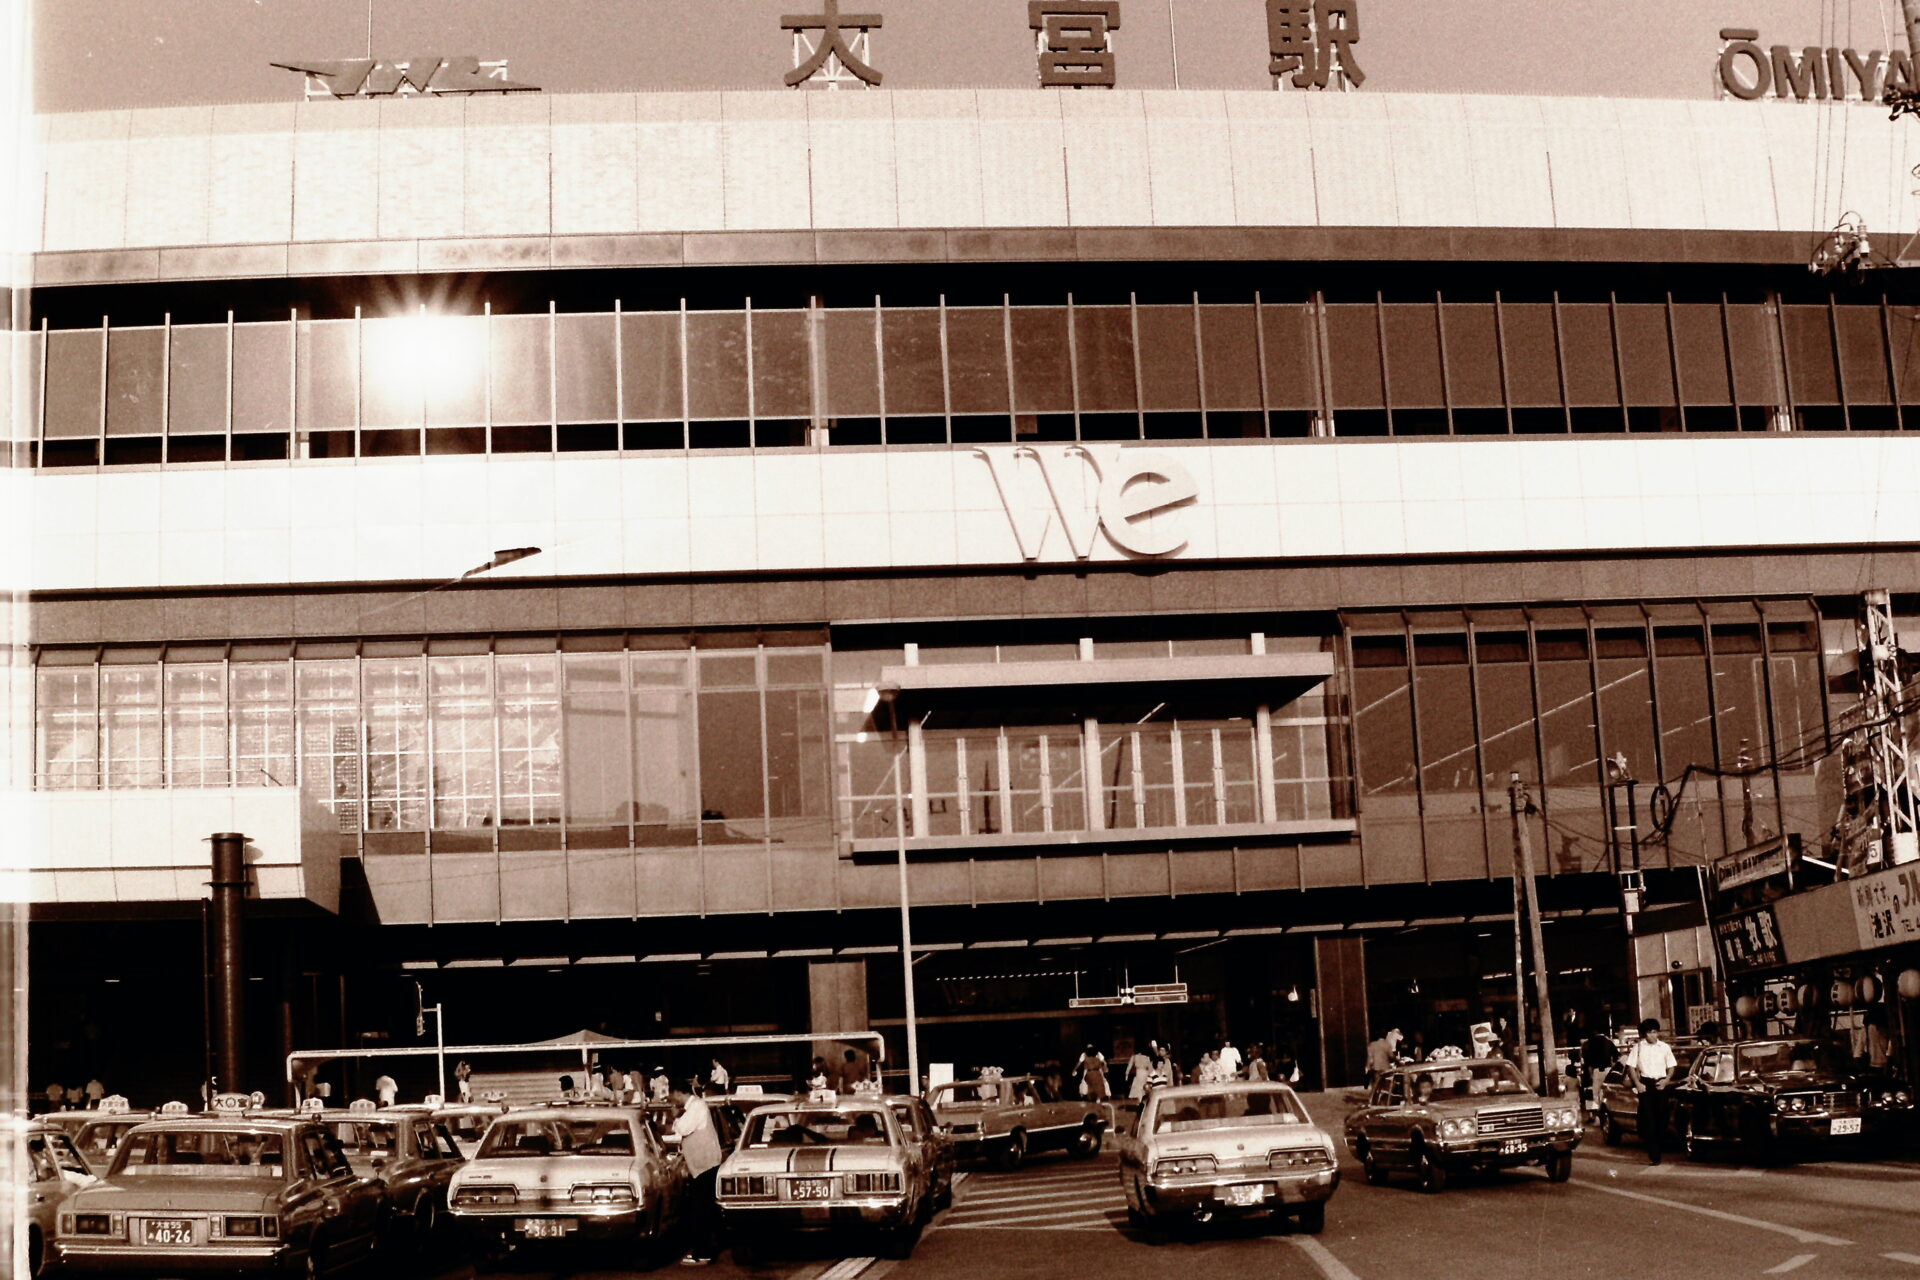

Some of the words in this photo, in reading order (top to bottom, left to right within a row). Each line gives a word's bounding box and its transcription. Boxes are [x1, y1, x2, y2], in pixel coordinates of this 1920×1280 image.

[780, 0, 1367, 89] 大宮駅
[972, 444, 1200, 563] We
[799, 1186, 829, 1198] 57-50
[155, 1229, 191, 1243] 40-26
